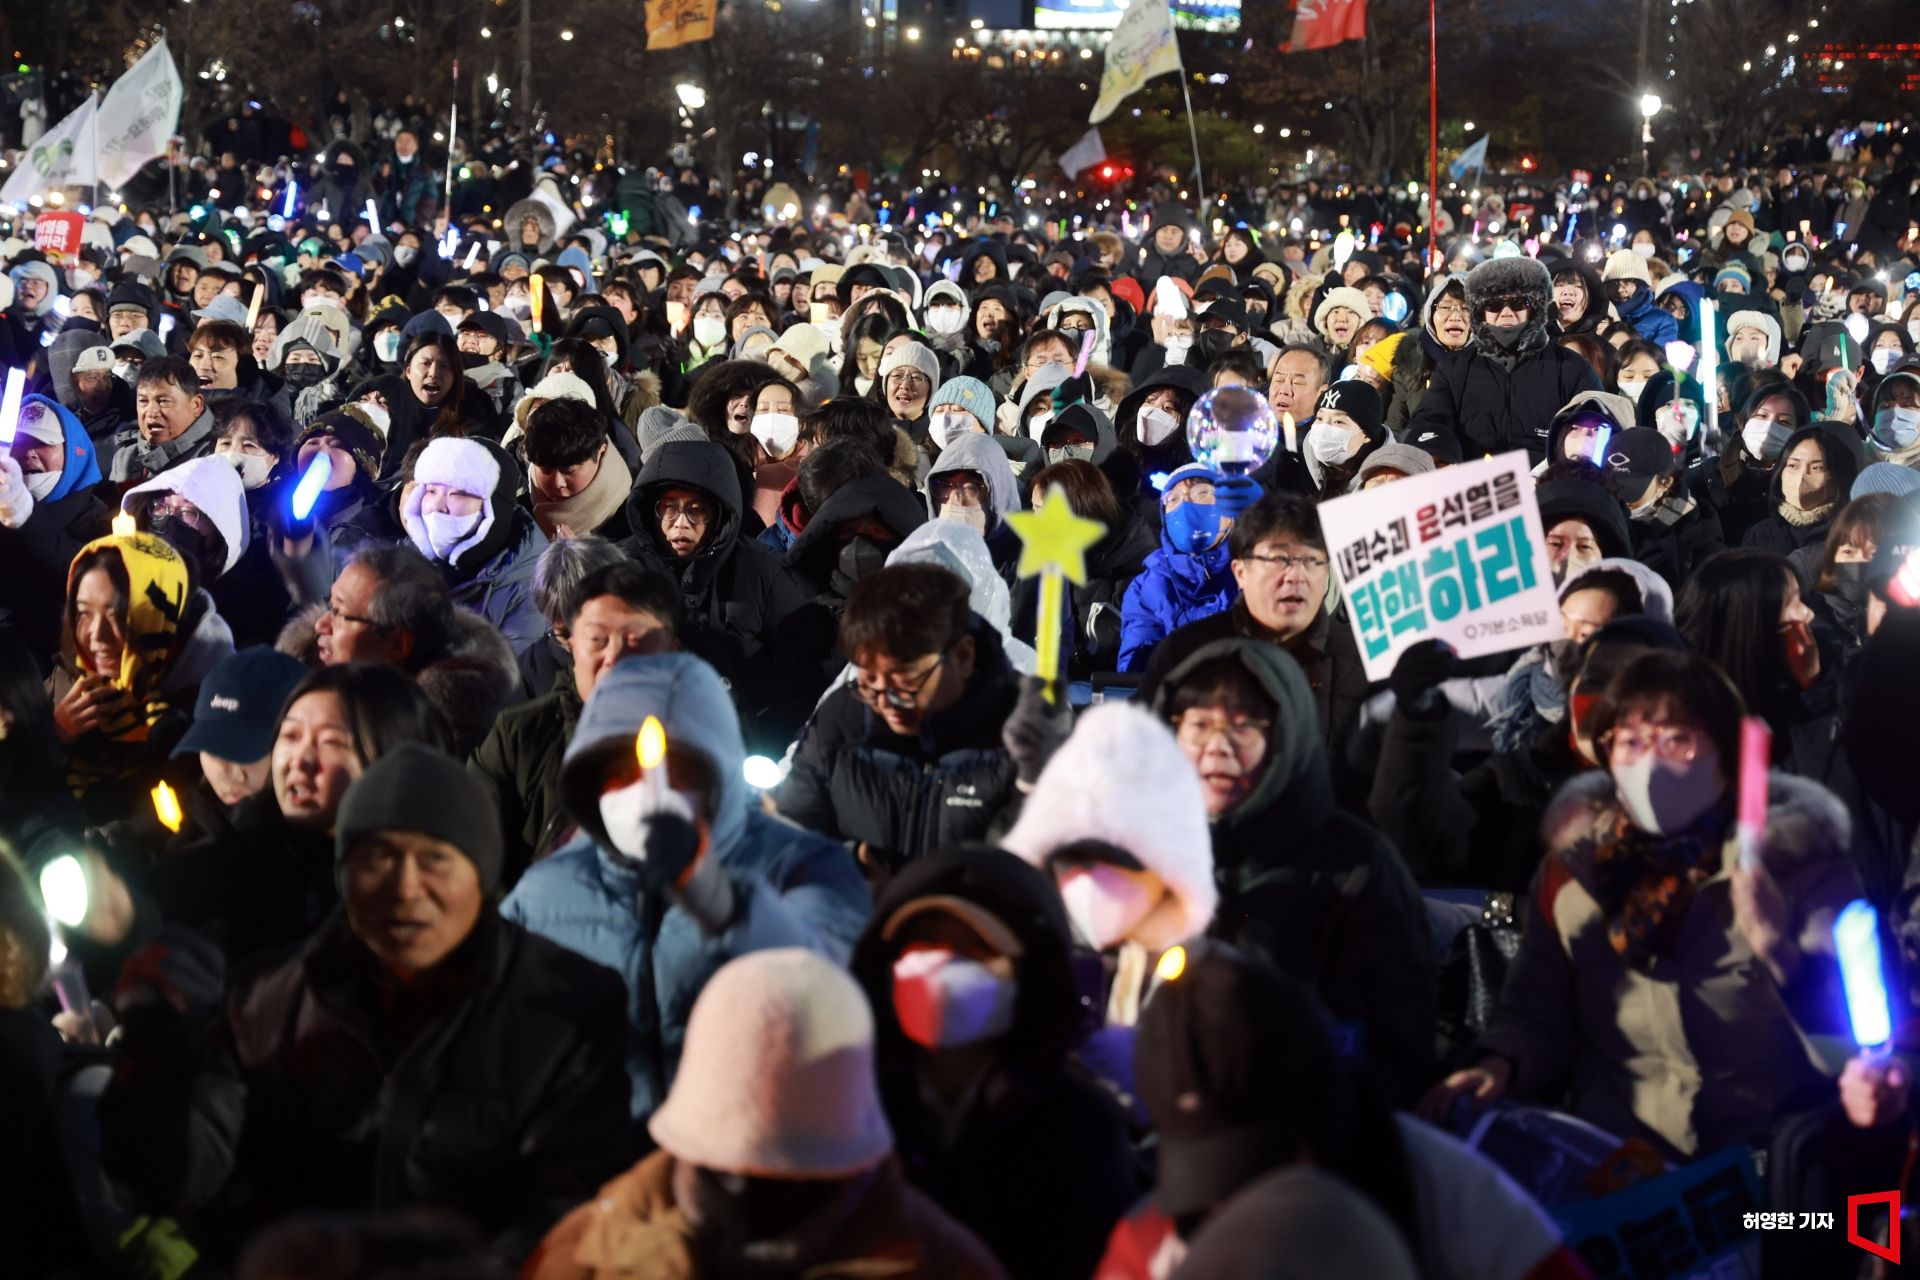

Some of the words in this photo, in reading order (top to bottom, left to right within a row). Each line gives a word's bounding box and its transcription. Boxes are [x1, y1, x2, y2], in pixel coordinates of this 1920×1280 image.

[1320, 389, 1341, 409] NY
[1337, 516, 1411, 584] 내란수괴
[1416, 470, 1522, 544] 윤석열을
[1350, 514, 1537, 661] 탄핵하라
[210, 693, 240, 712] Jeep
